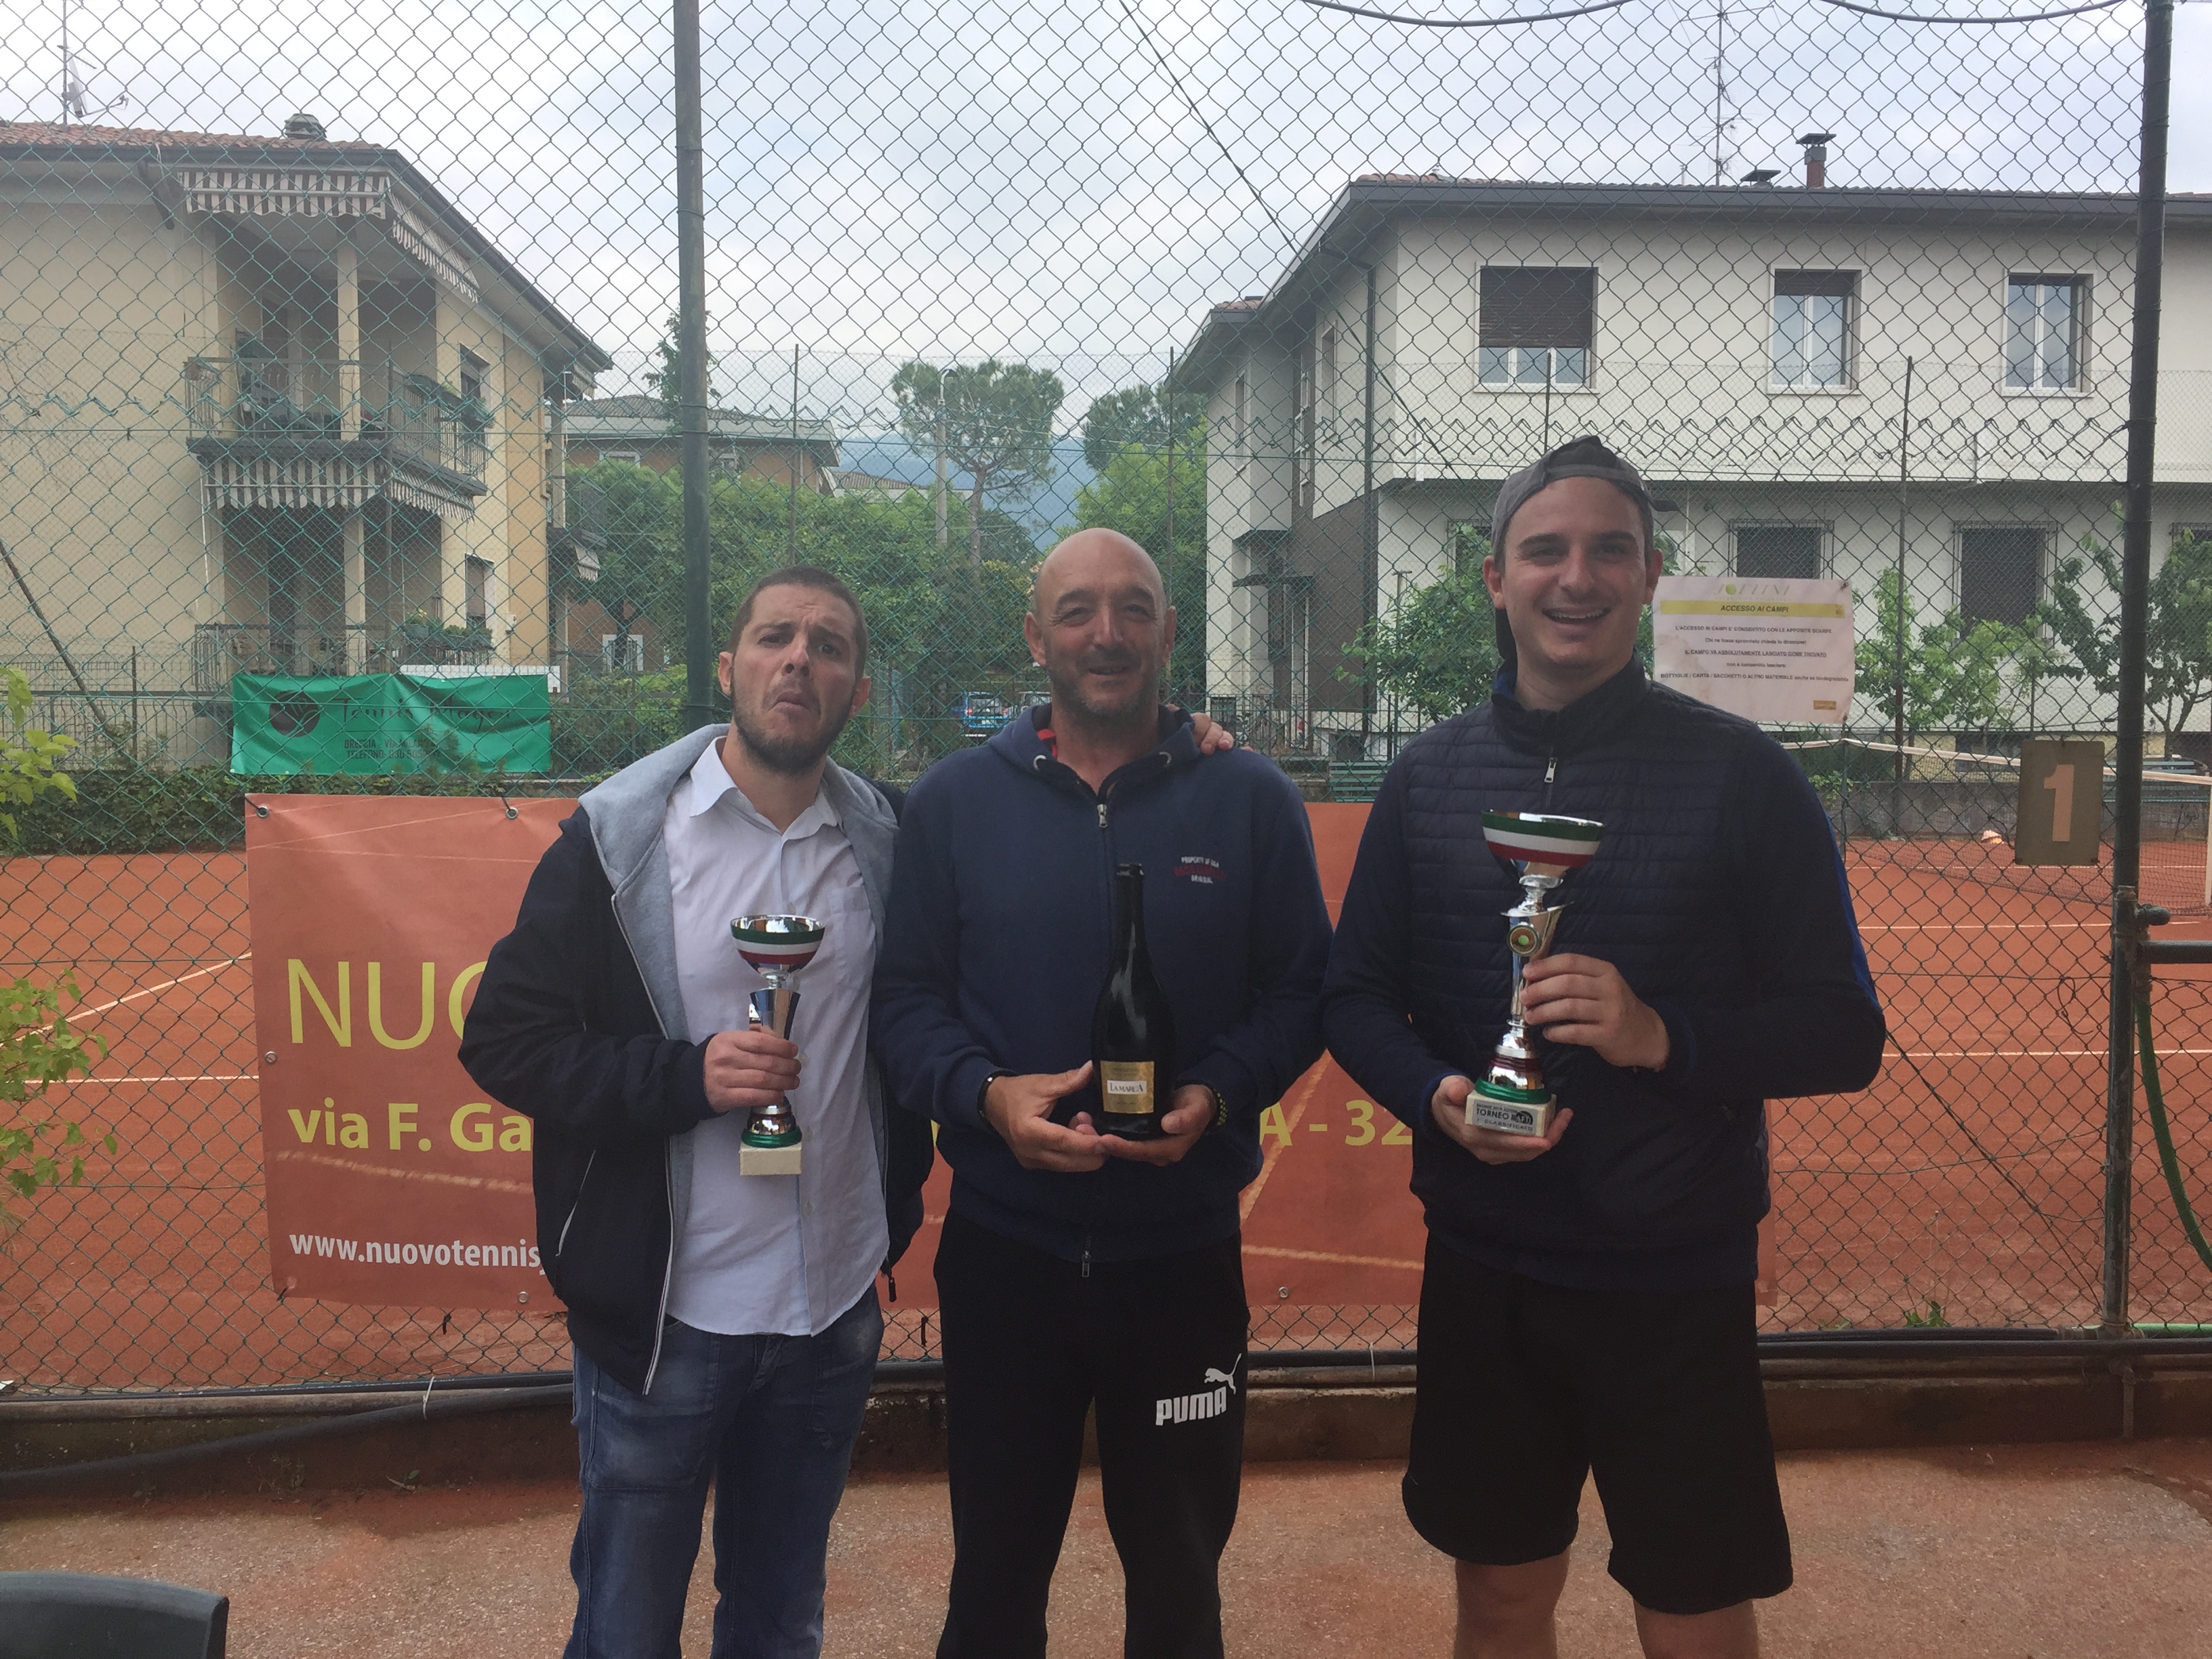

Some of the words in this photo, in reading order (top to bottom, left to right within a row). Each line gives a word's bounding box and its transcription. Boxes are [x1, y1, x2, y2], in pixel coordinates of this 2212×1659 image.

[331, 697, 413, 722] Tennis
[2043, 764, 2074, 842] 1
[287, 1097, 369, 1149] via
[388, 1103, 432, 1152] F.
[1476, 1108, 1509, 1120] TORNEO
[1484, 1119, 1533, 1131] CLASSIFICATO
[289, 1233, 546, 1275] www.nuovotennis
[1155, 1386, 1227, 1426] PUMA
